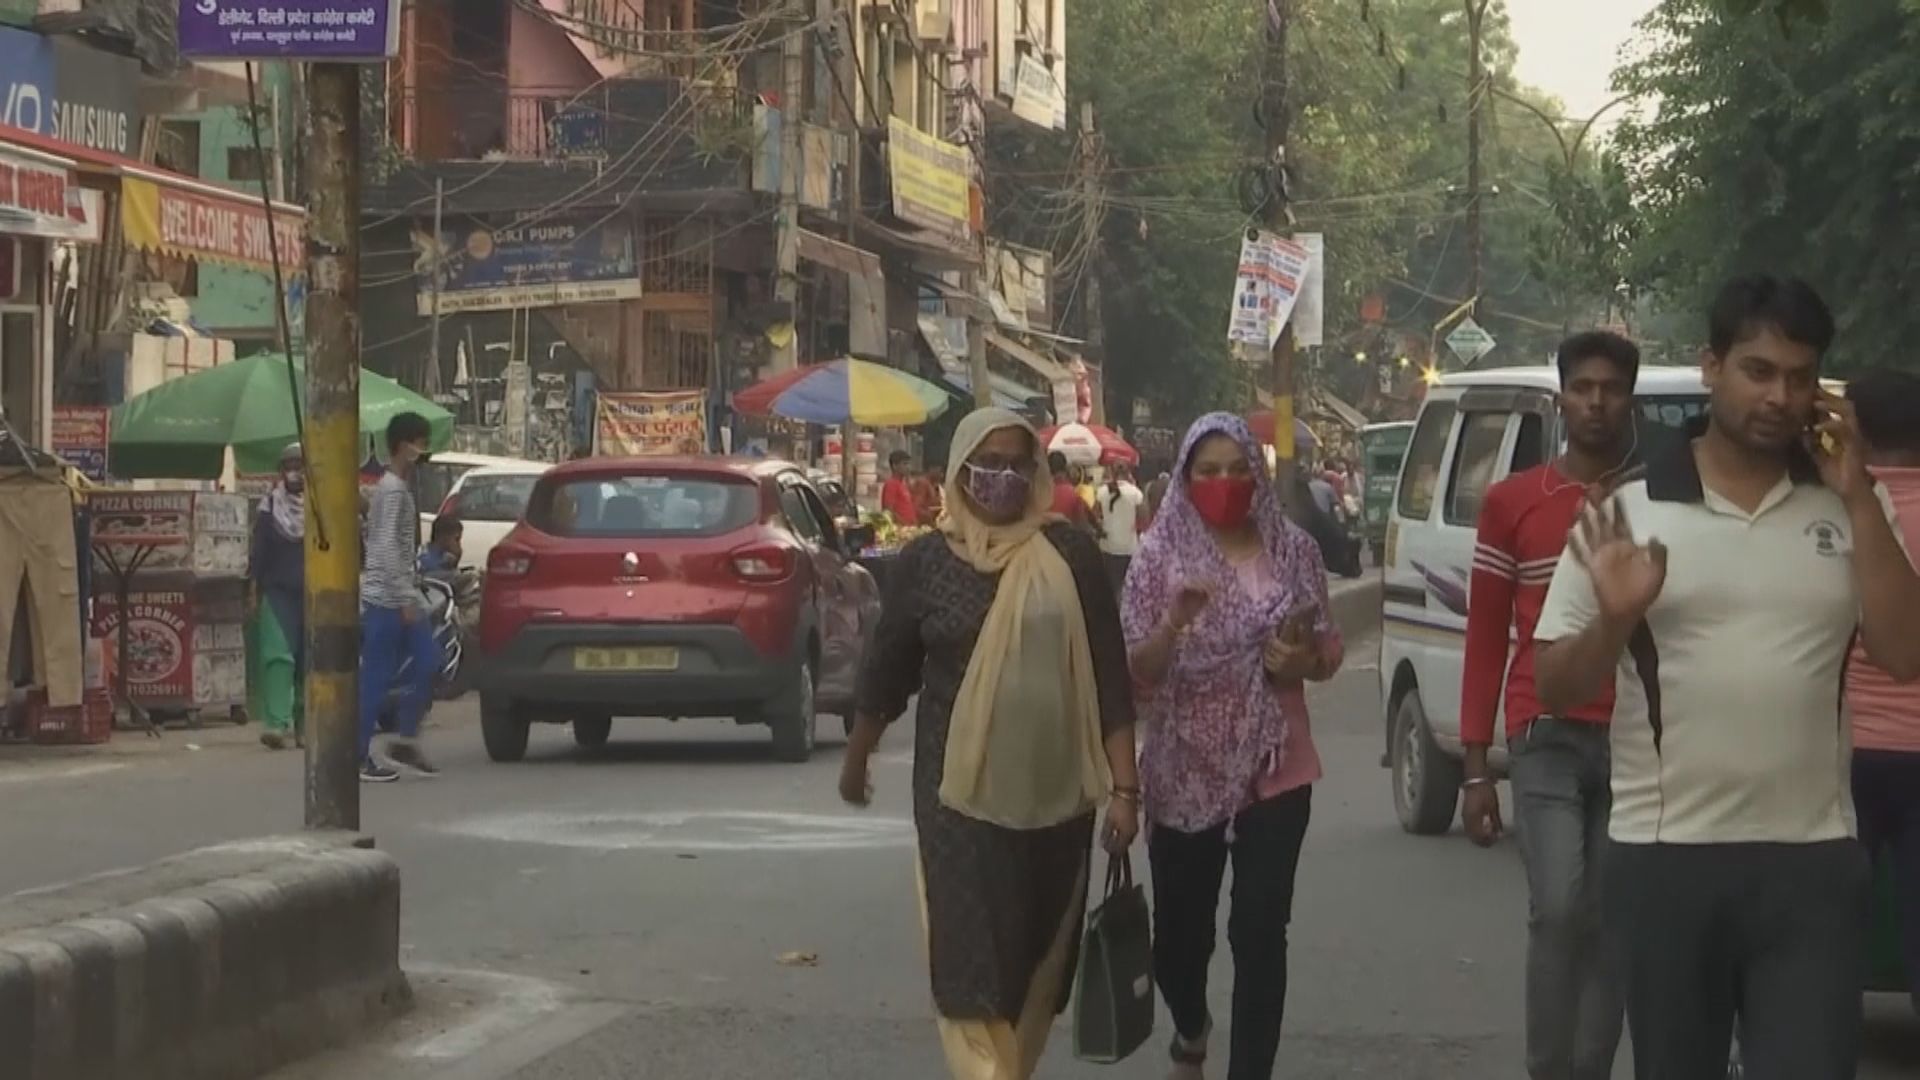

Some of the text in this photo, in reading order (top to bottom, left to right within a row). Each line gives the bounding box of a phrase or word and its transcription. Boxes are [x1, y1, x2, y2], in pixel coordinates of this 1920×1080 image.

[258, 7, 285, 24] दिल्ली
[287, 8, 310, 26] प्रदेश
[347, 7, 376, 25] कमेटी
[51, 99, 127, 152] SAMSUNG
[161, 198, 239, 250] WELCOME
[529, 226, 576, 241] PUMPS
[93, 495, 189, 512] PIZZA CORNER
[146, 592, 185, 604] SWEETS
[134, 606, 186, 632] CORNER
